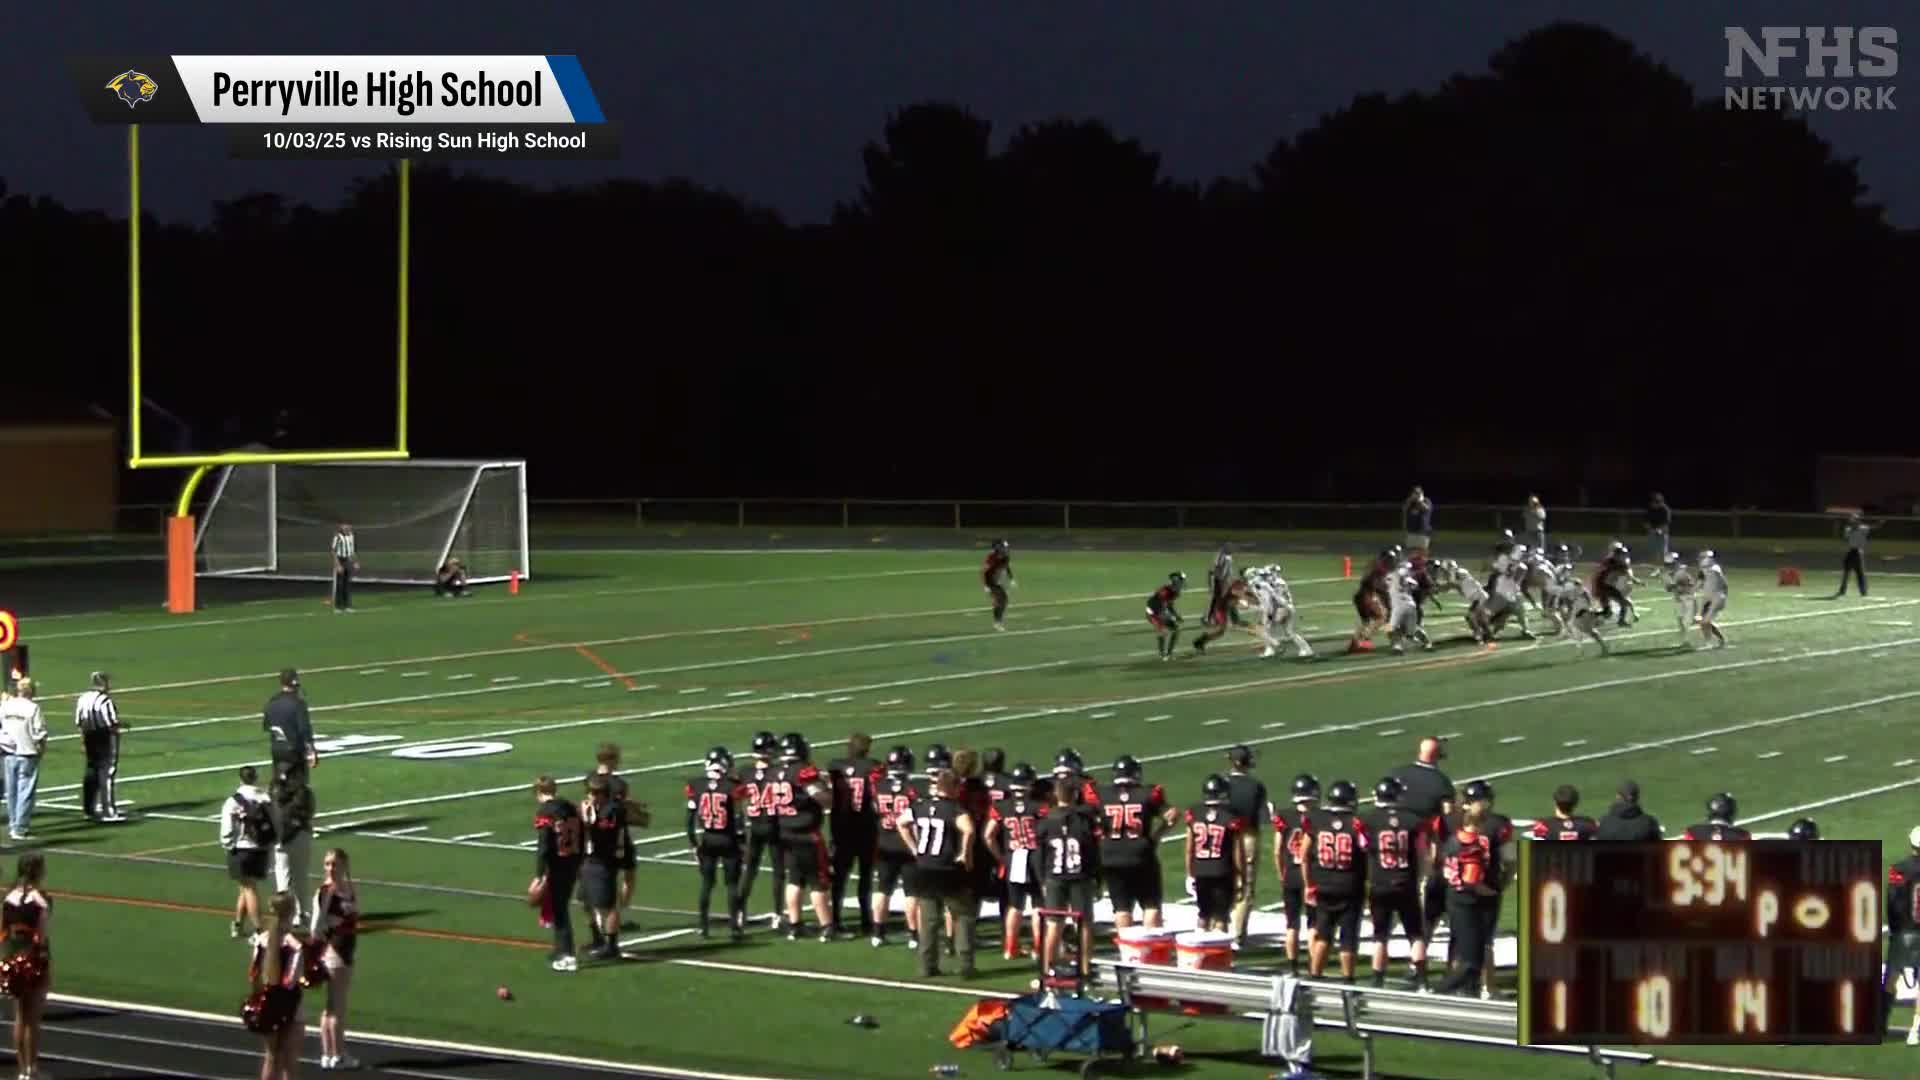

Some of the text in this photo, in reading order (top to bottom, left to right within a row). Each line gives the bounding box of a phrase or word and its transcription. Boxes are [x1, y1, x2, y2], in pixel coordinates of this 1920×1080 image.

[699, 792, 728, 830] 45
[1104, 803, 1143, 839] 75
[1192, 821, 1226, 859] 27
[1667, 845, 1748, 906] 5:34
[1540, 881, 1567, 943] 0
[1850, 881, 1877, 943] 0
[1551, 979, 1568, 1032] 1
[1636, 974, 1672, 1038] 10
[1838, 979, 1855, 1032] 1
